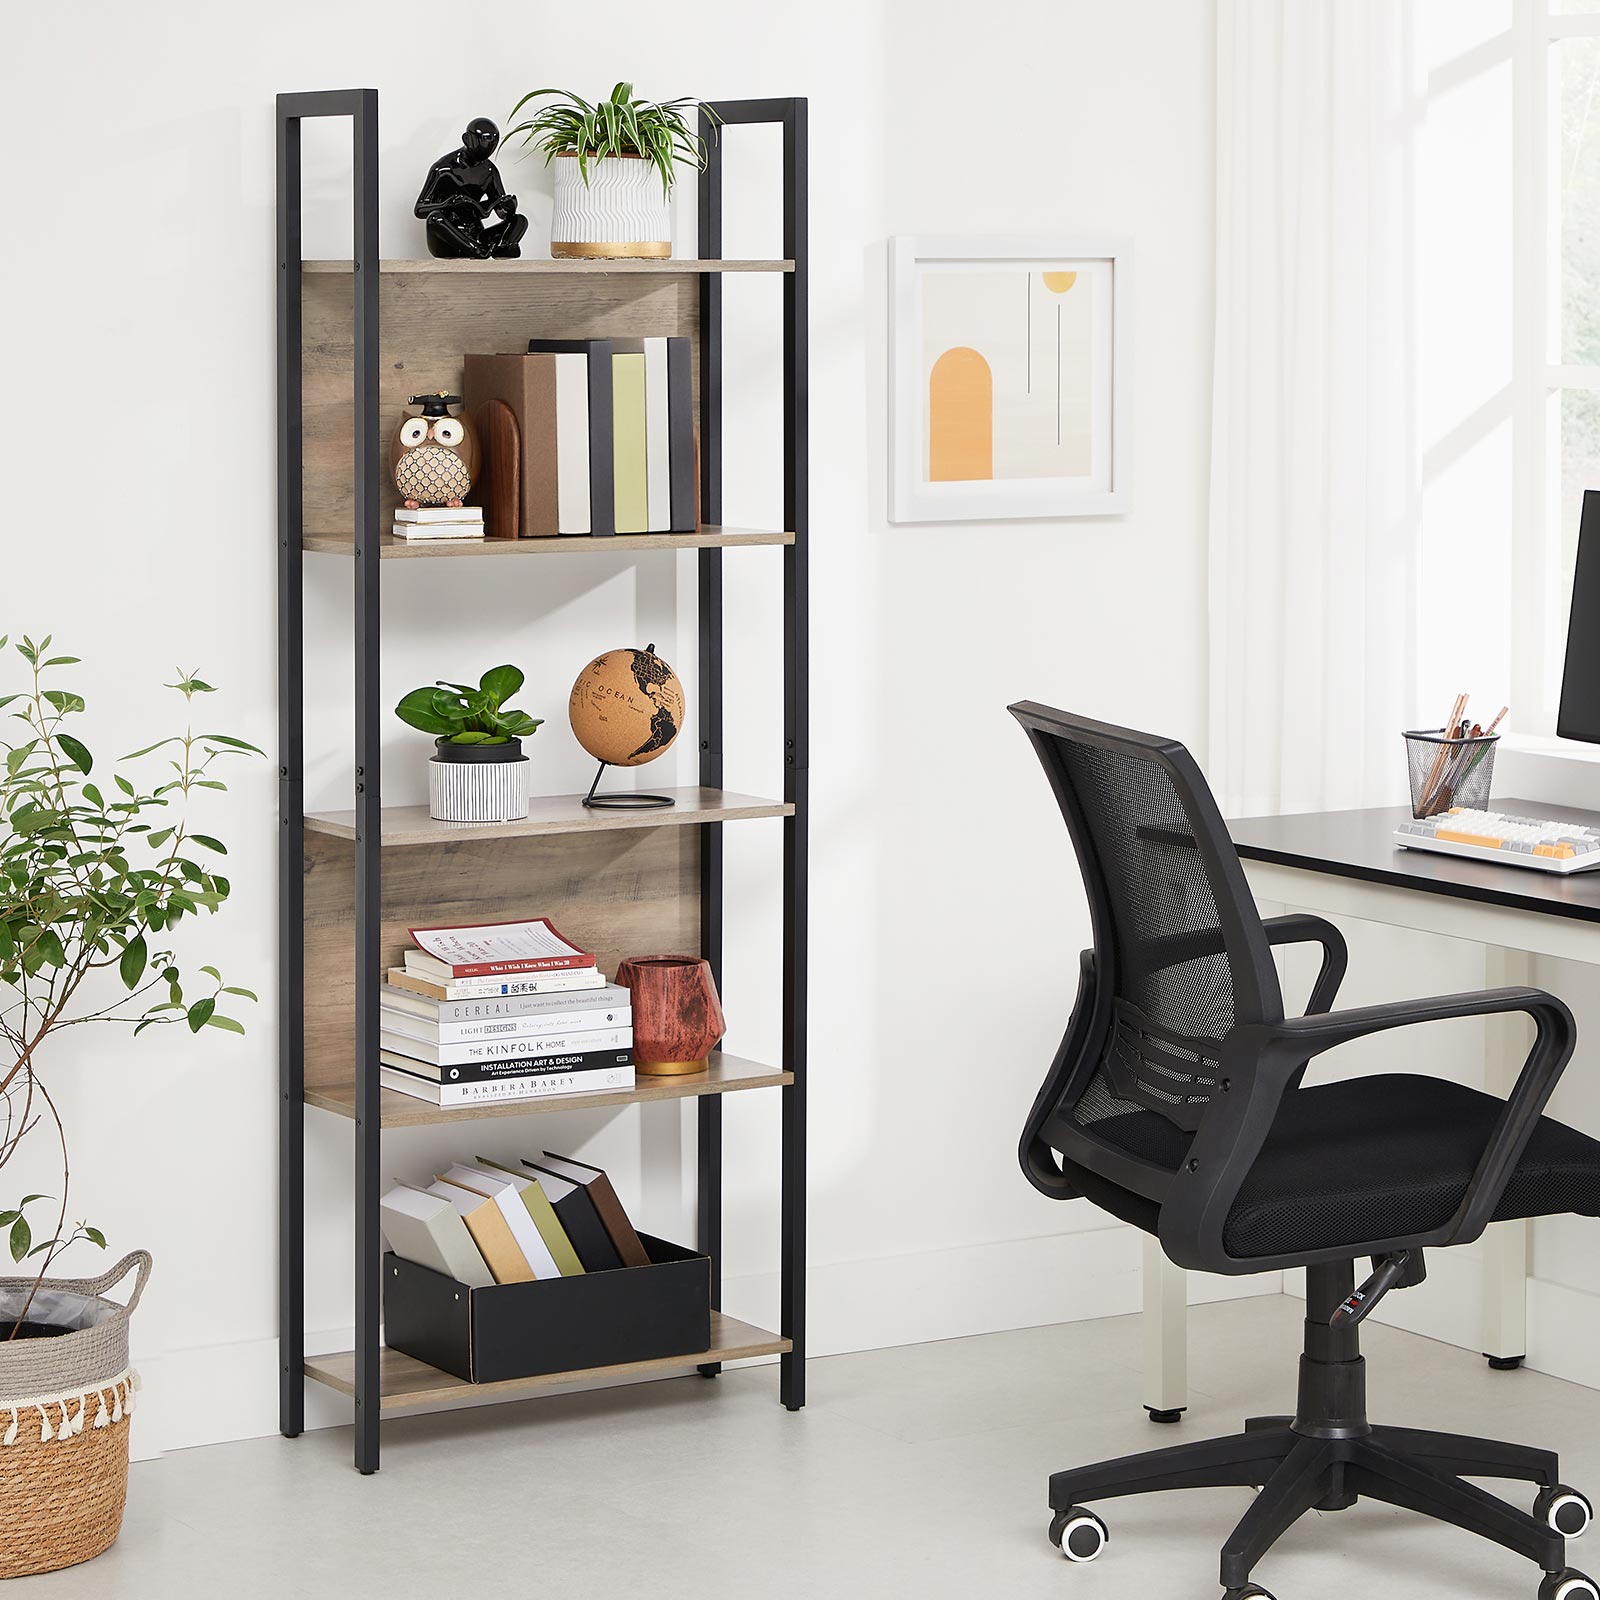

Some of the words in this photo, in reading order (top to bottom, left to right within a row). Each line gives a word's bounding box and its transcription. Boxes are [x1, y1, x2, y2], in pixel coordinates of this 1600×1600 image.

[598, 685, 634, 703] OCEAN
[454, 1003, 510, 1018] CEREAL
[597, 995, 614, 1003] things
[460, 1027, 483, 1035] LIGHT
[484, 1023, 517, 1034] DESIGNS
[469, 1048, 483, 1056] THE
[486, 1041, 544, 1056] KINFOLK
[545, 1040, 566, 1049] HOME
[480, 1059, 533, 1072] INSTALLATION
[533, 1058, 548, 1067] ART
[548, 1058, 555, 1066] &
[555, 1055, 583, 1065] DESIGN
[499, 1068, 525, 1077] Experience
[546, 1064, 573, 1072] Technology
[462, 1082, 525, 1096] BARBERA
[530, 1077, 575, 1088] BAREY
